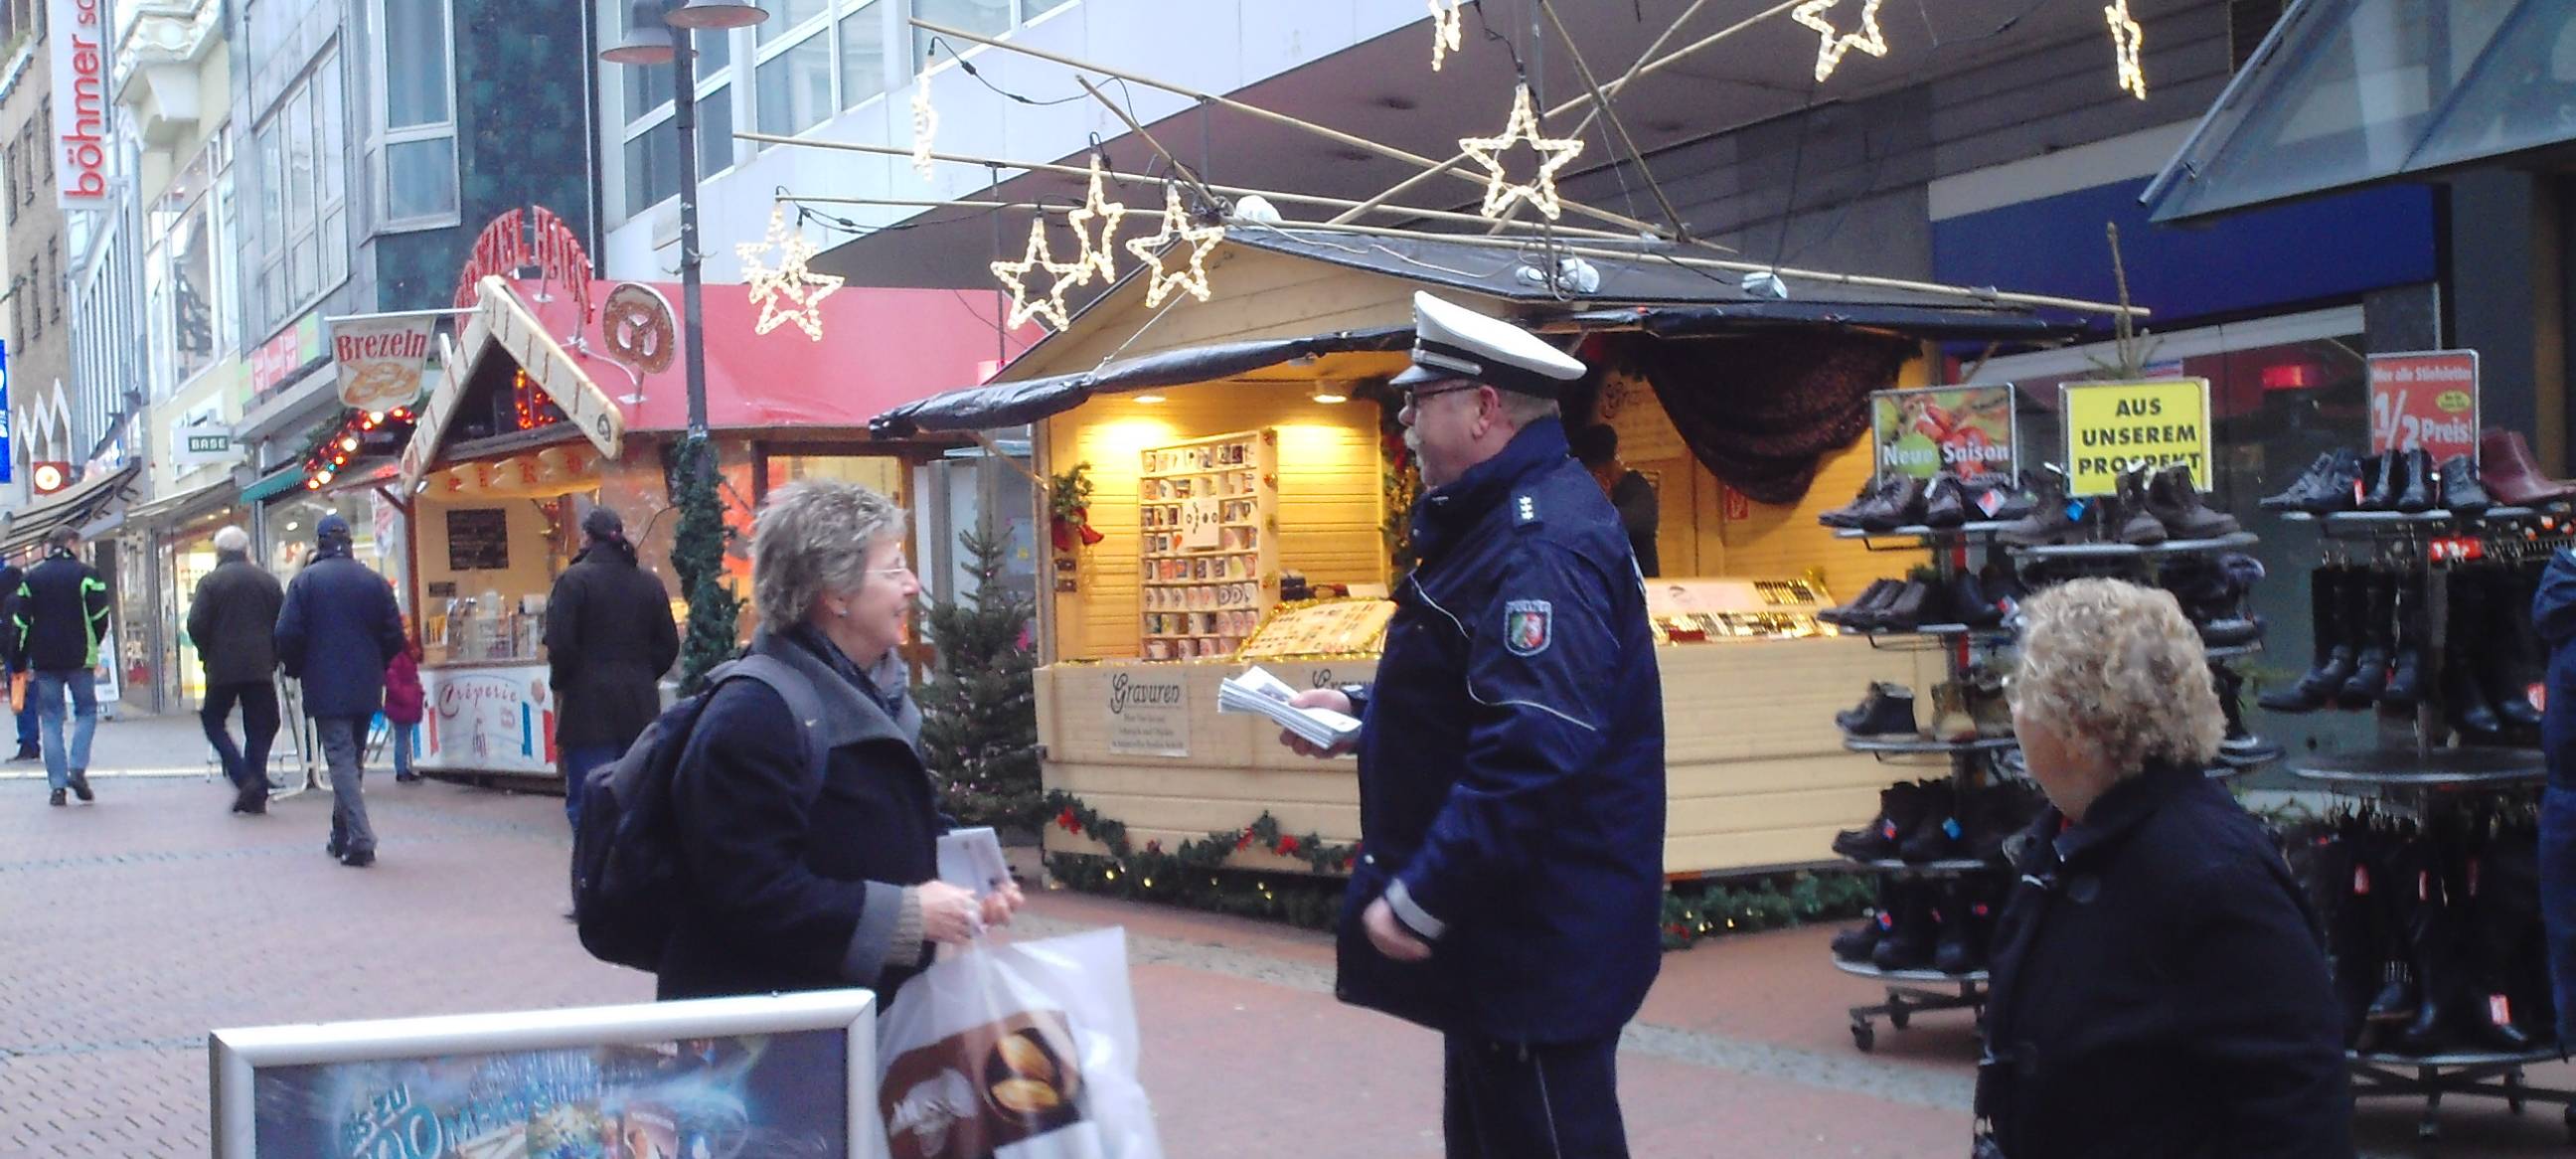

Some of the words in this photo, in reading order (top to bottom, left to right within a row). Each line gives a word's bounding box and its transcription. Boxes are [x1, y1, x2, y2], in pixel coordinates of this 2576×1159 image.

[62, 33, 105, 198] böhmer
[336, 329, 427, 362] Brezeln
[2116, 398, 2162, 417] AUS
[2082, 424, 2196, 447] UNSEREM
[2421, 415, 2474, 444] Preis!
[190, 437, 227, 451] BASE
[1882, 442, 1934, 465] Neue
[1942, 440, 2011, 464] Saison
[1110, 672, 1182, 715] Gravuren
